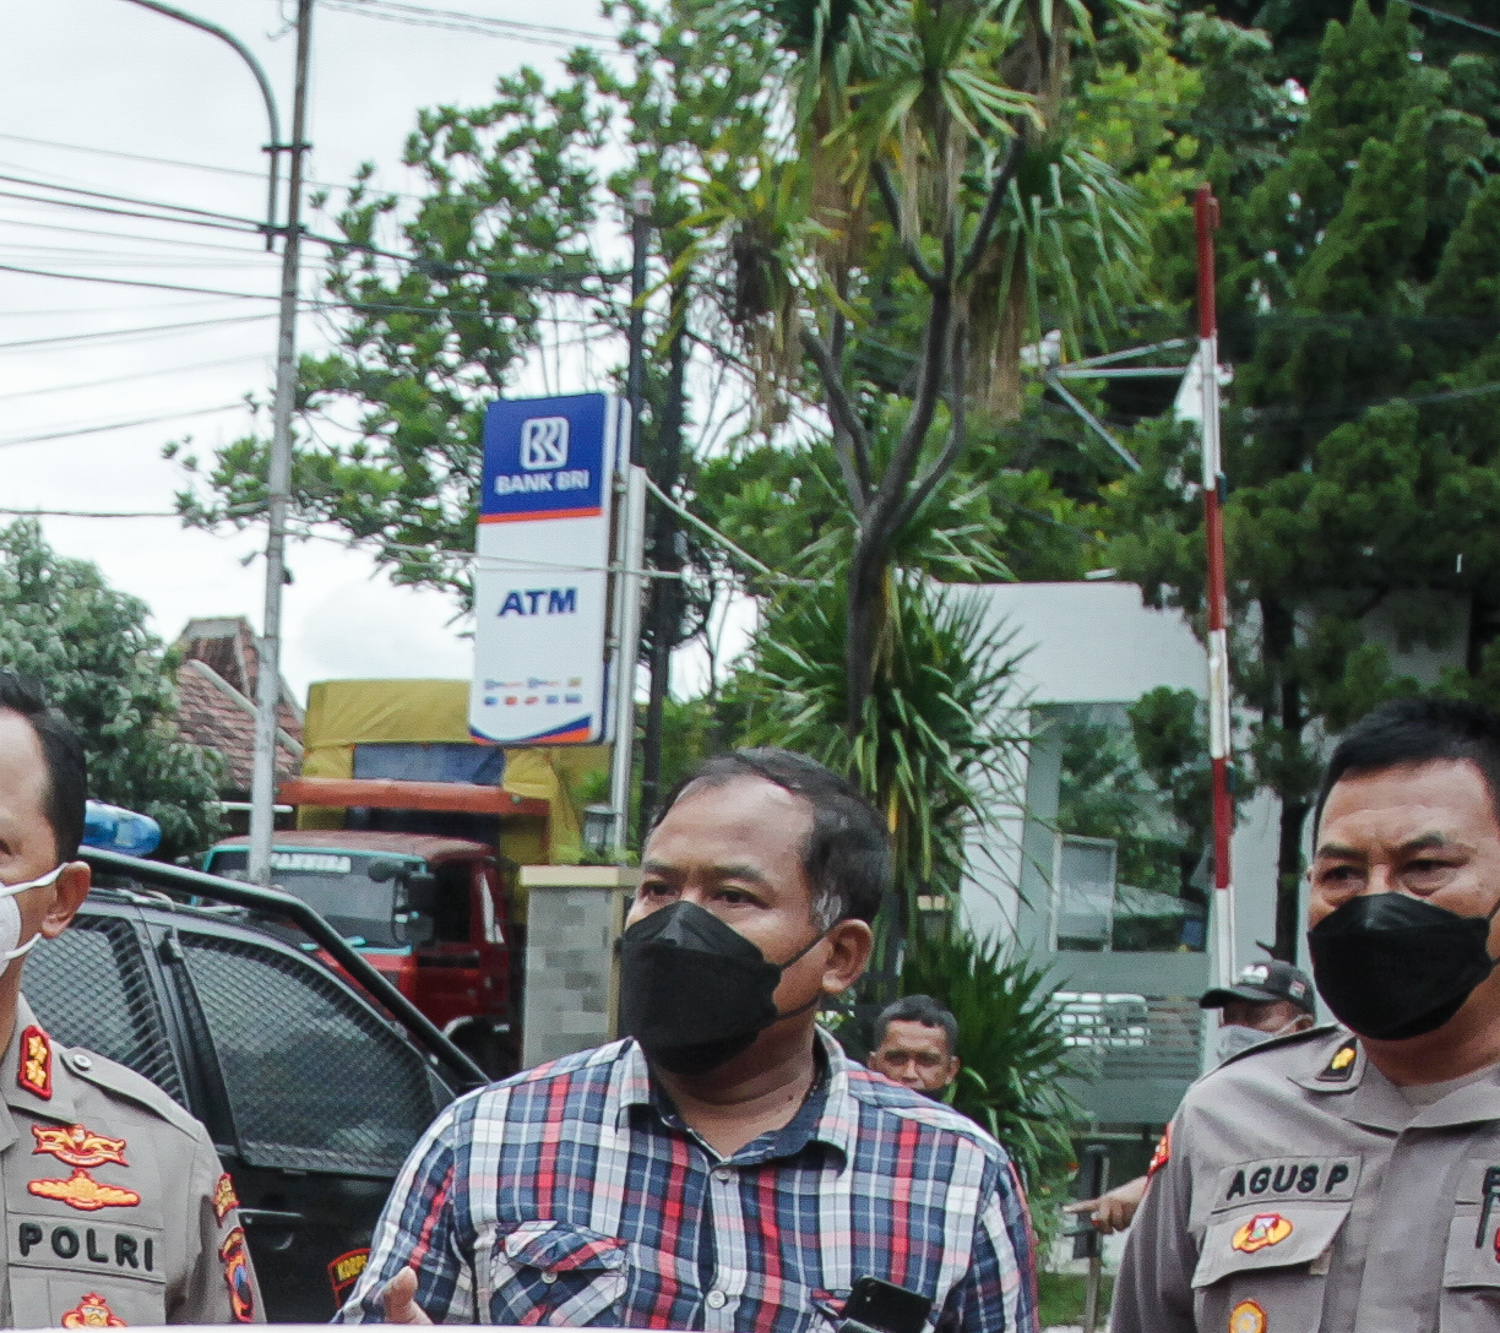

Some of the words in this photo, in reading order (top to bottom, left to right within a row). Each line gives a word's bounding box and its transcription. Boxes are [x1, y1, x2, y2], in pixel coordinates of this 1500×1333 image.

[494, 470, 553, 496] BANK
[556, 467, 590, 491] BRI
[497, 587, 578, 617] ATM
[1226, 1163, 1320, 1201] AGUS
[1324, 1163, 1350, 1195] P
[18, 1221, 154, 1273] POLRI
